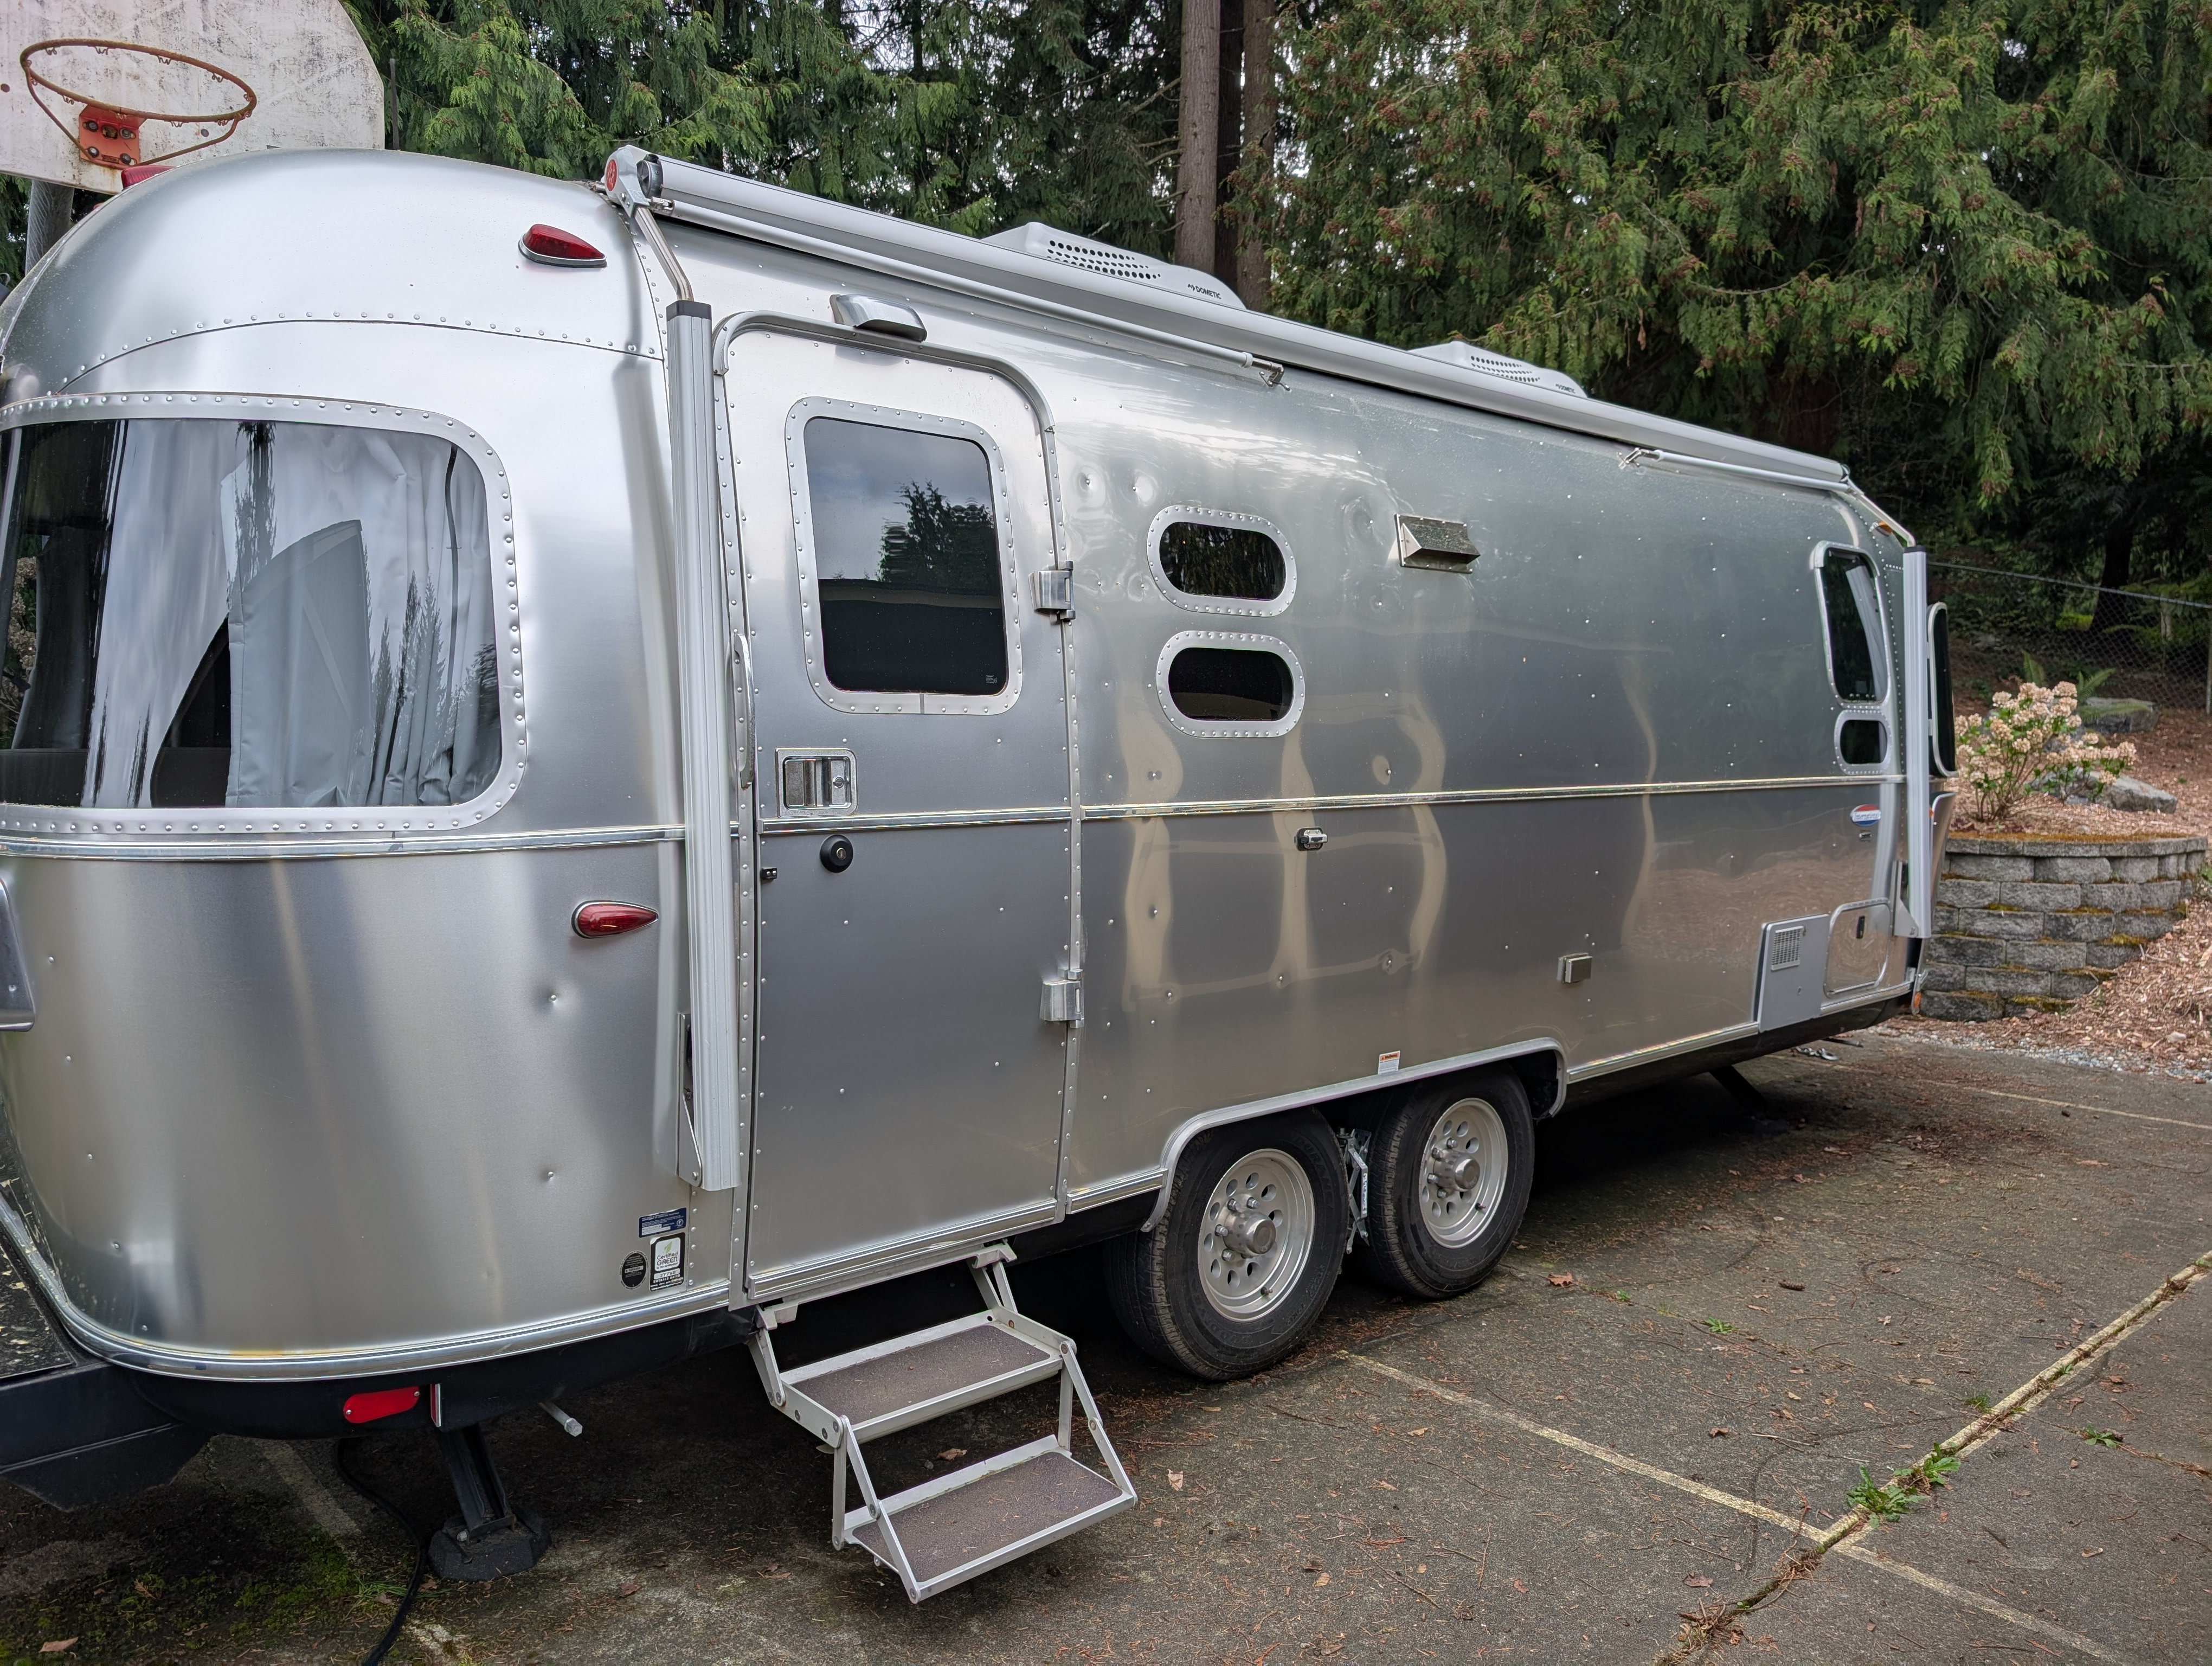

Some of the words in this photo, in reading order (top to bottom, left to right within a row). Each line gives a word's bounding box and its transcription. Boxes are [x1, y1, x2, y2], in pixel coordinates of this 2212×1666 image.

[1195, 285, 1221, 299] DOMETIC
[657, 1251, 678, 1260] Certified
[657, 1257, 678, 1266] GREEN
